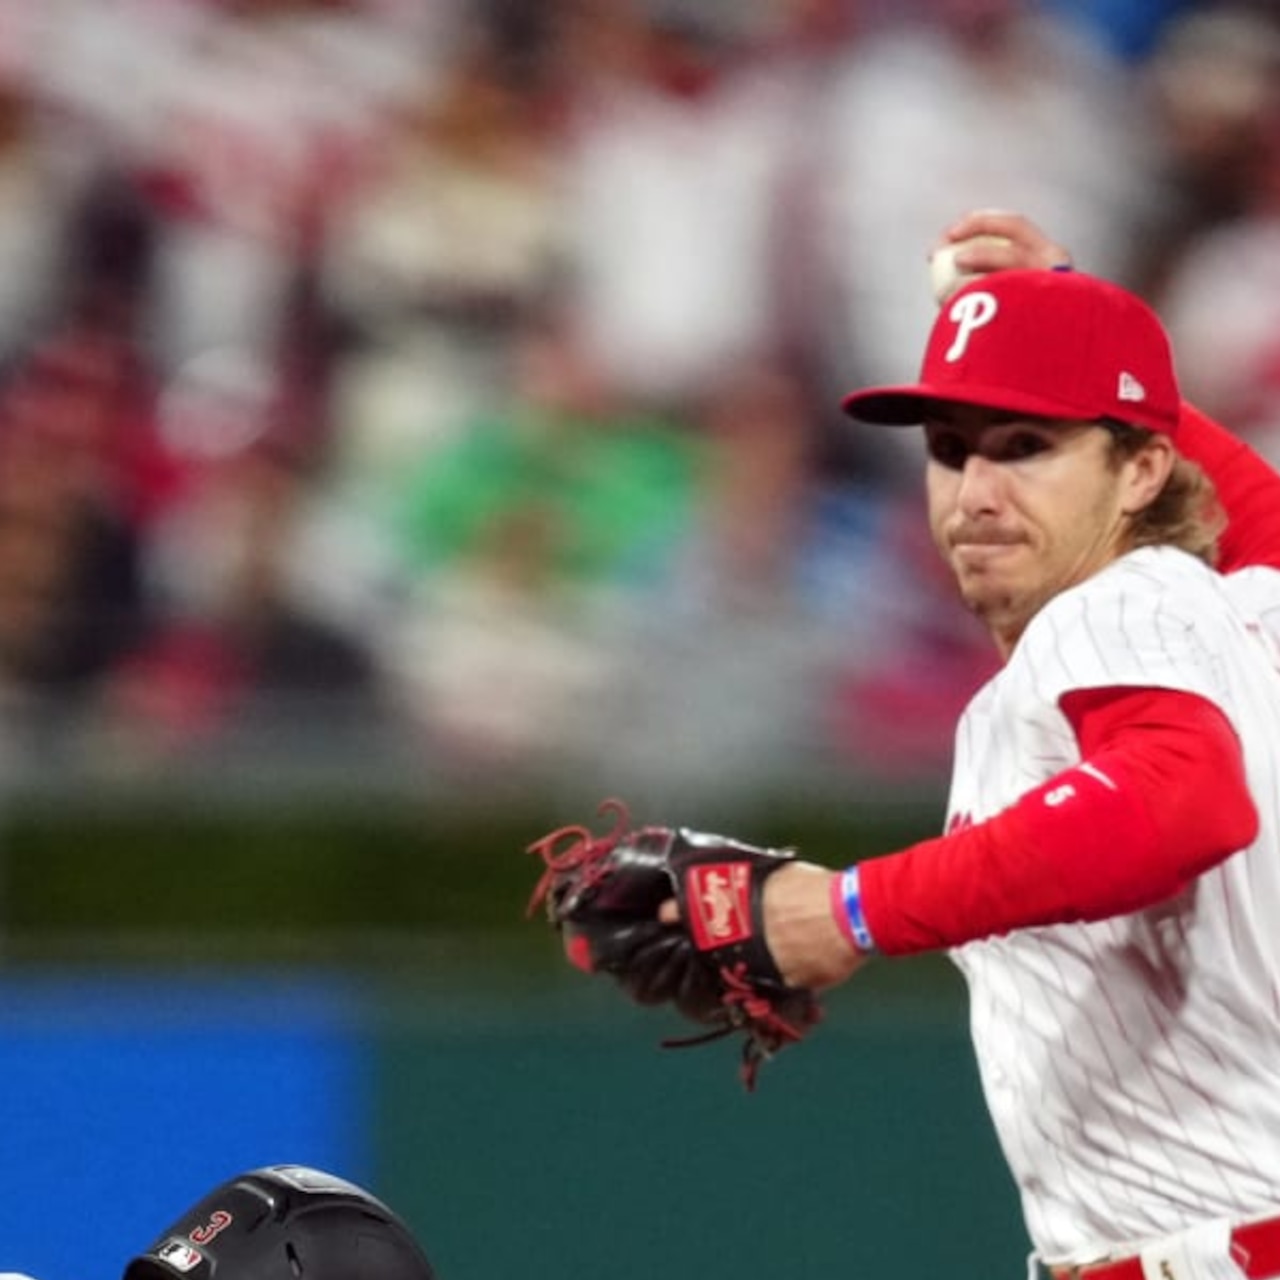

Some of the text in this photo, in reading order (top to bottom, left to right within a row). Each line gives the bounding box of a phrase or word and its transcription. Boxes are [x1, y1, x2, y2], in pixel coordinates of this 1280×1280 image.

[944, 291, 999, 364] P
[1043, 783, 1077, 808] 5
[189, 1210, 232, 1246] 3
